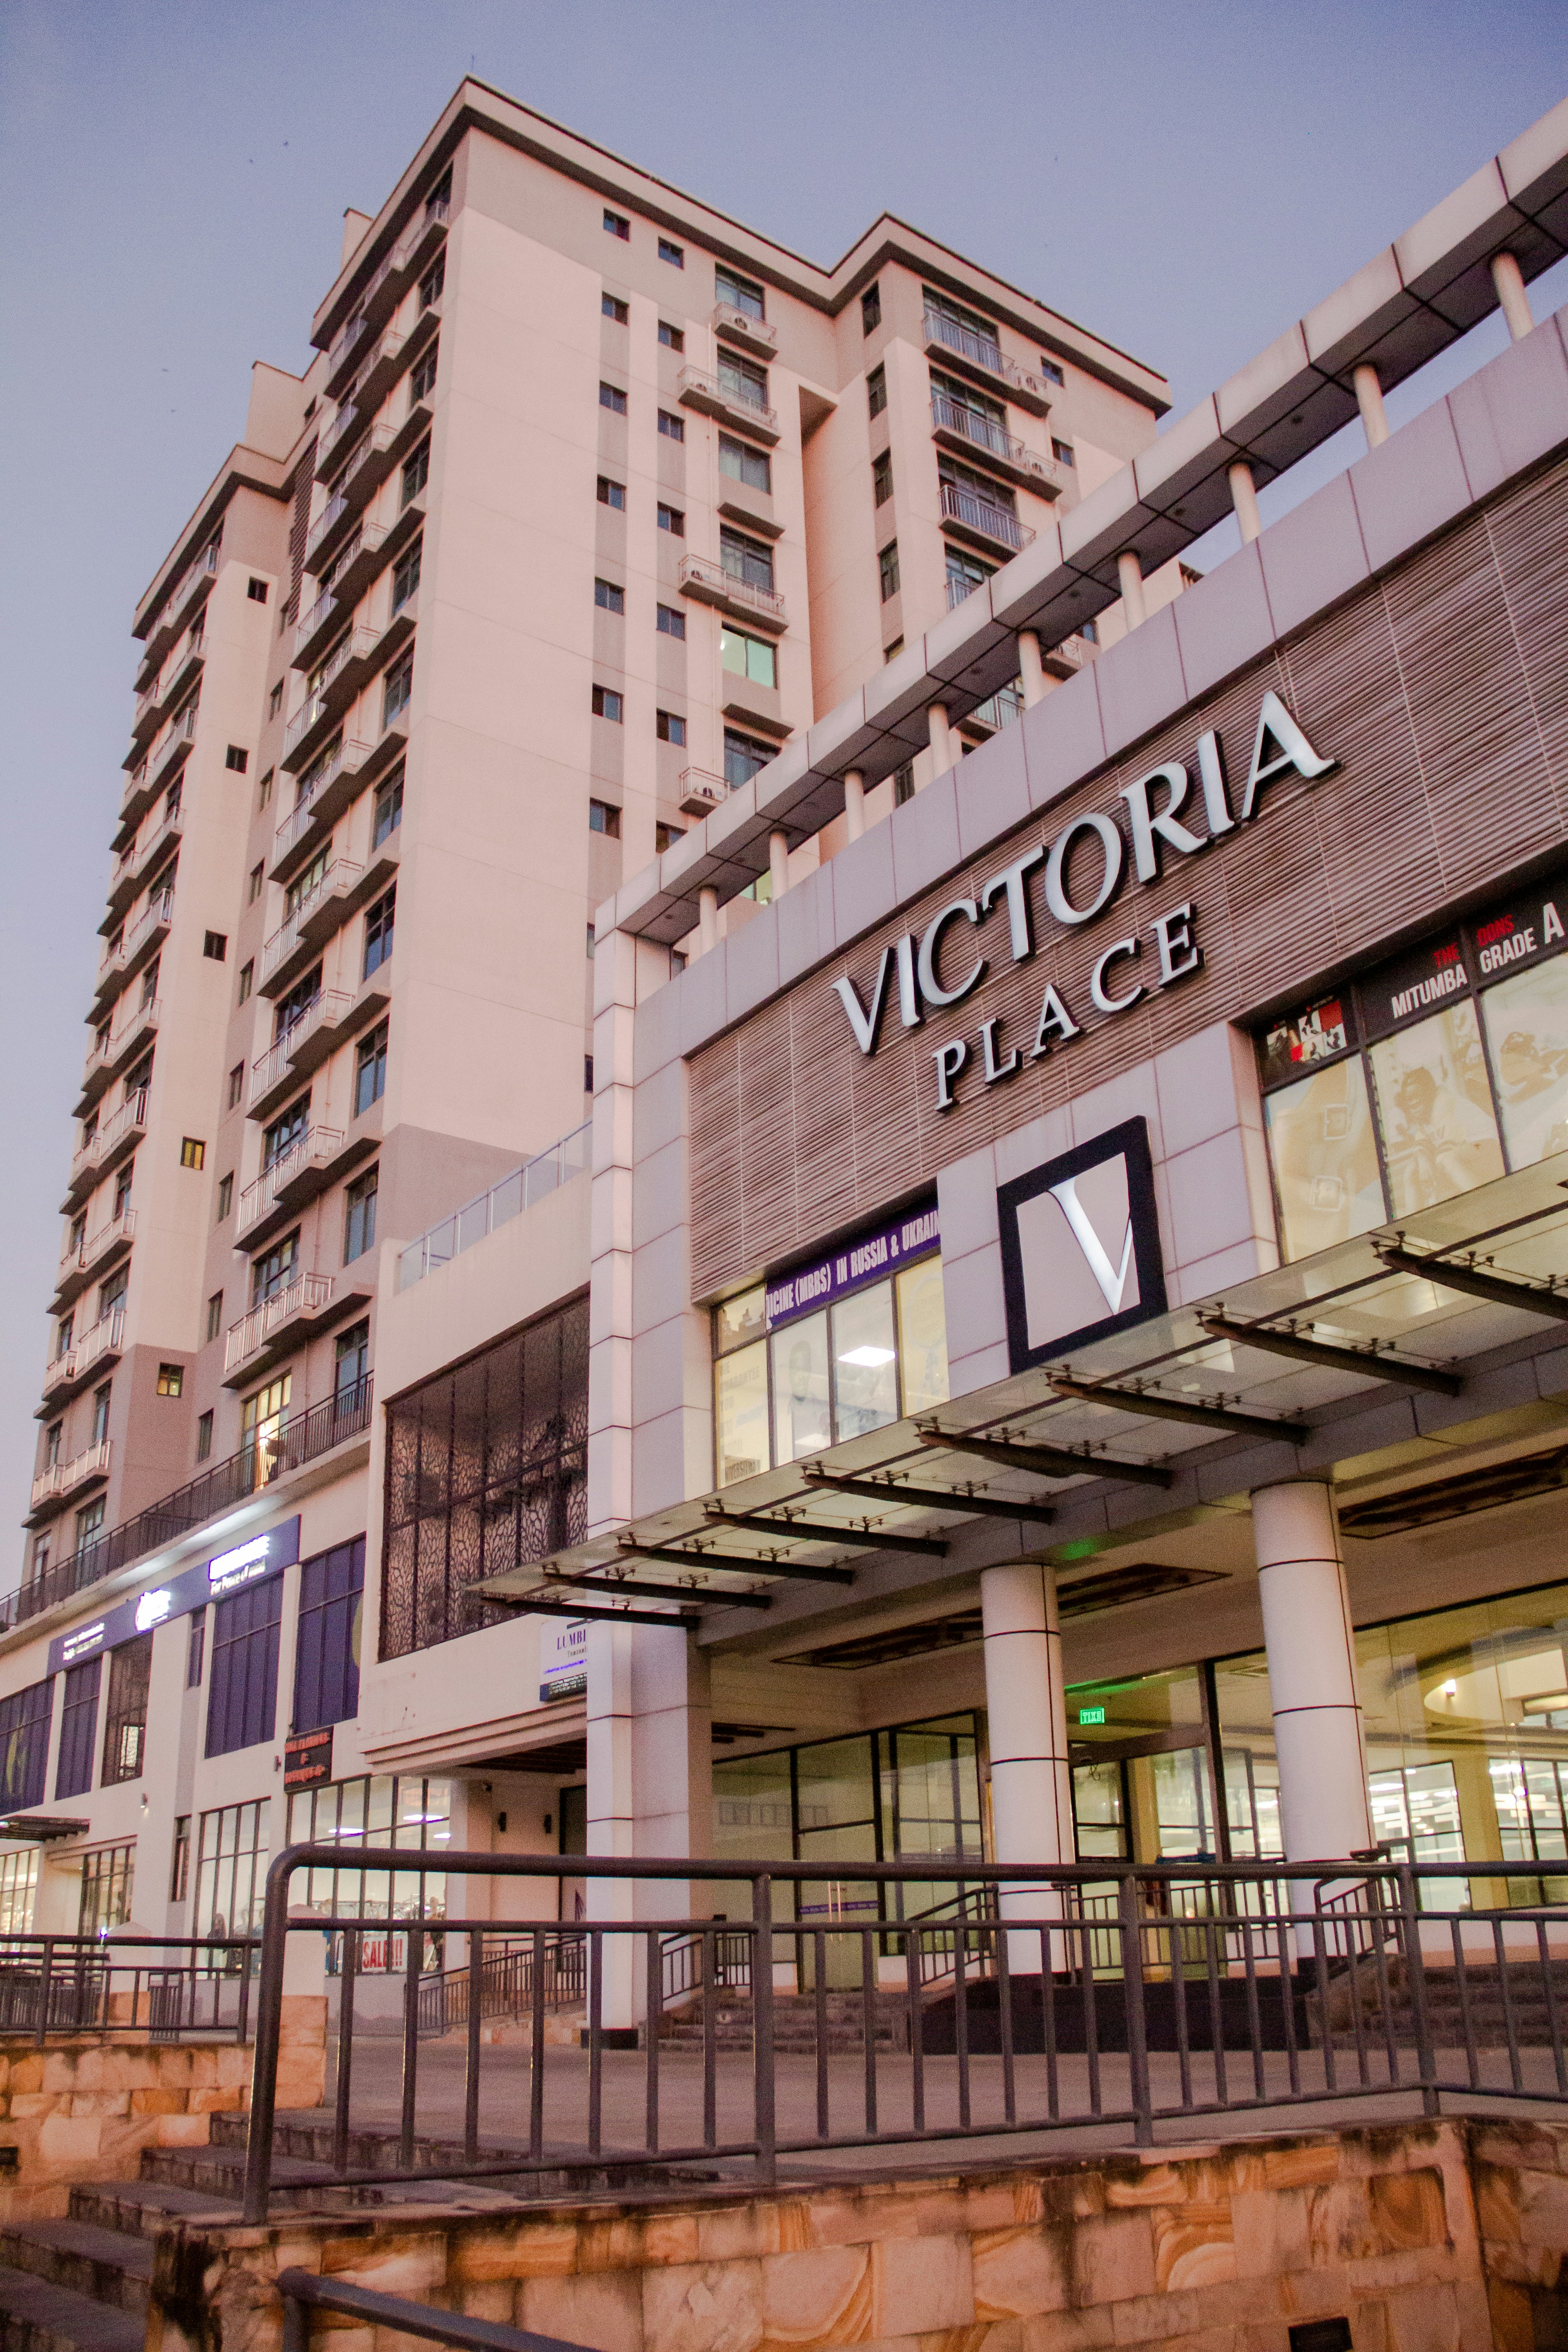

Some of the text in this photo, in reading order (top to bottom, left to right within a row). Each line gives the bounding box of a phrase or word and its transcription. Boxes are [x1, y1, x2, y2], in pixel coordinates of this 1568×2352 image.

[830, 689, 1336, 1055] VICTORIA
[1391, 902, 1565, 1019] MITUMBA GRADE A
[1433, 914, 1514, 969] THE DONS
[931, 903, 1200, 1111] PLACE
[794, 1263, 832, 1306] (MBBS)
[836, 1256, 848, 1285] IN
[850, 1236, 888, 1278] RUSSIA
[891, 1235, 899, 1257] &
[1048, 1176, 1133, 1316] V
